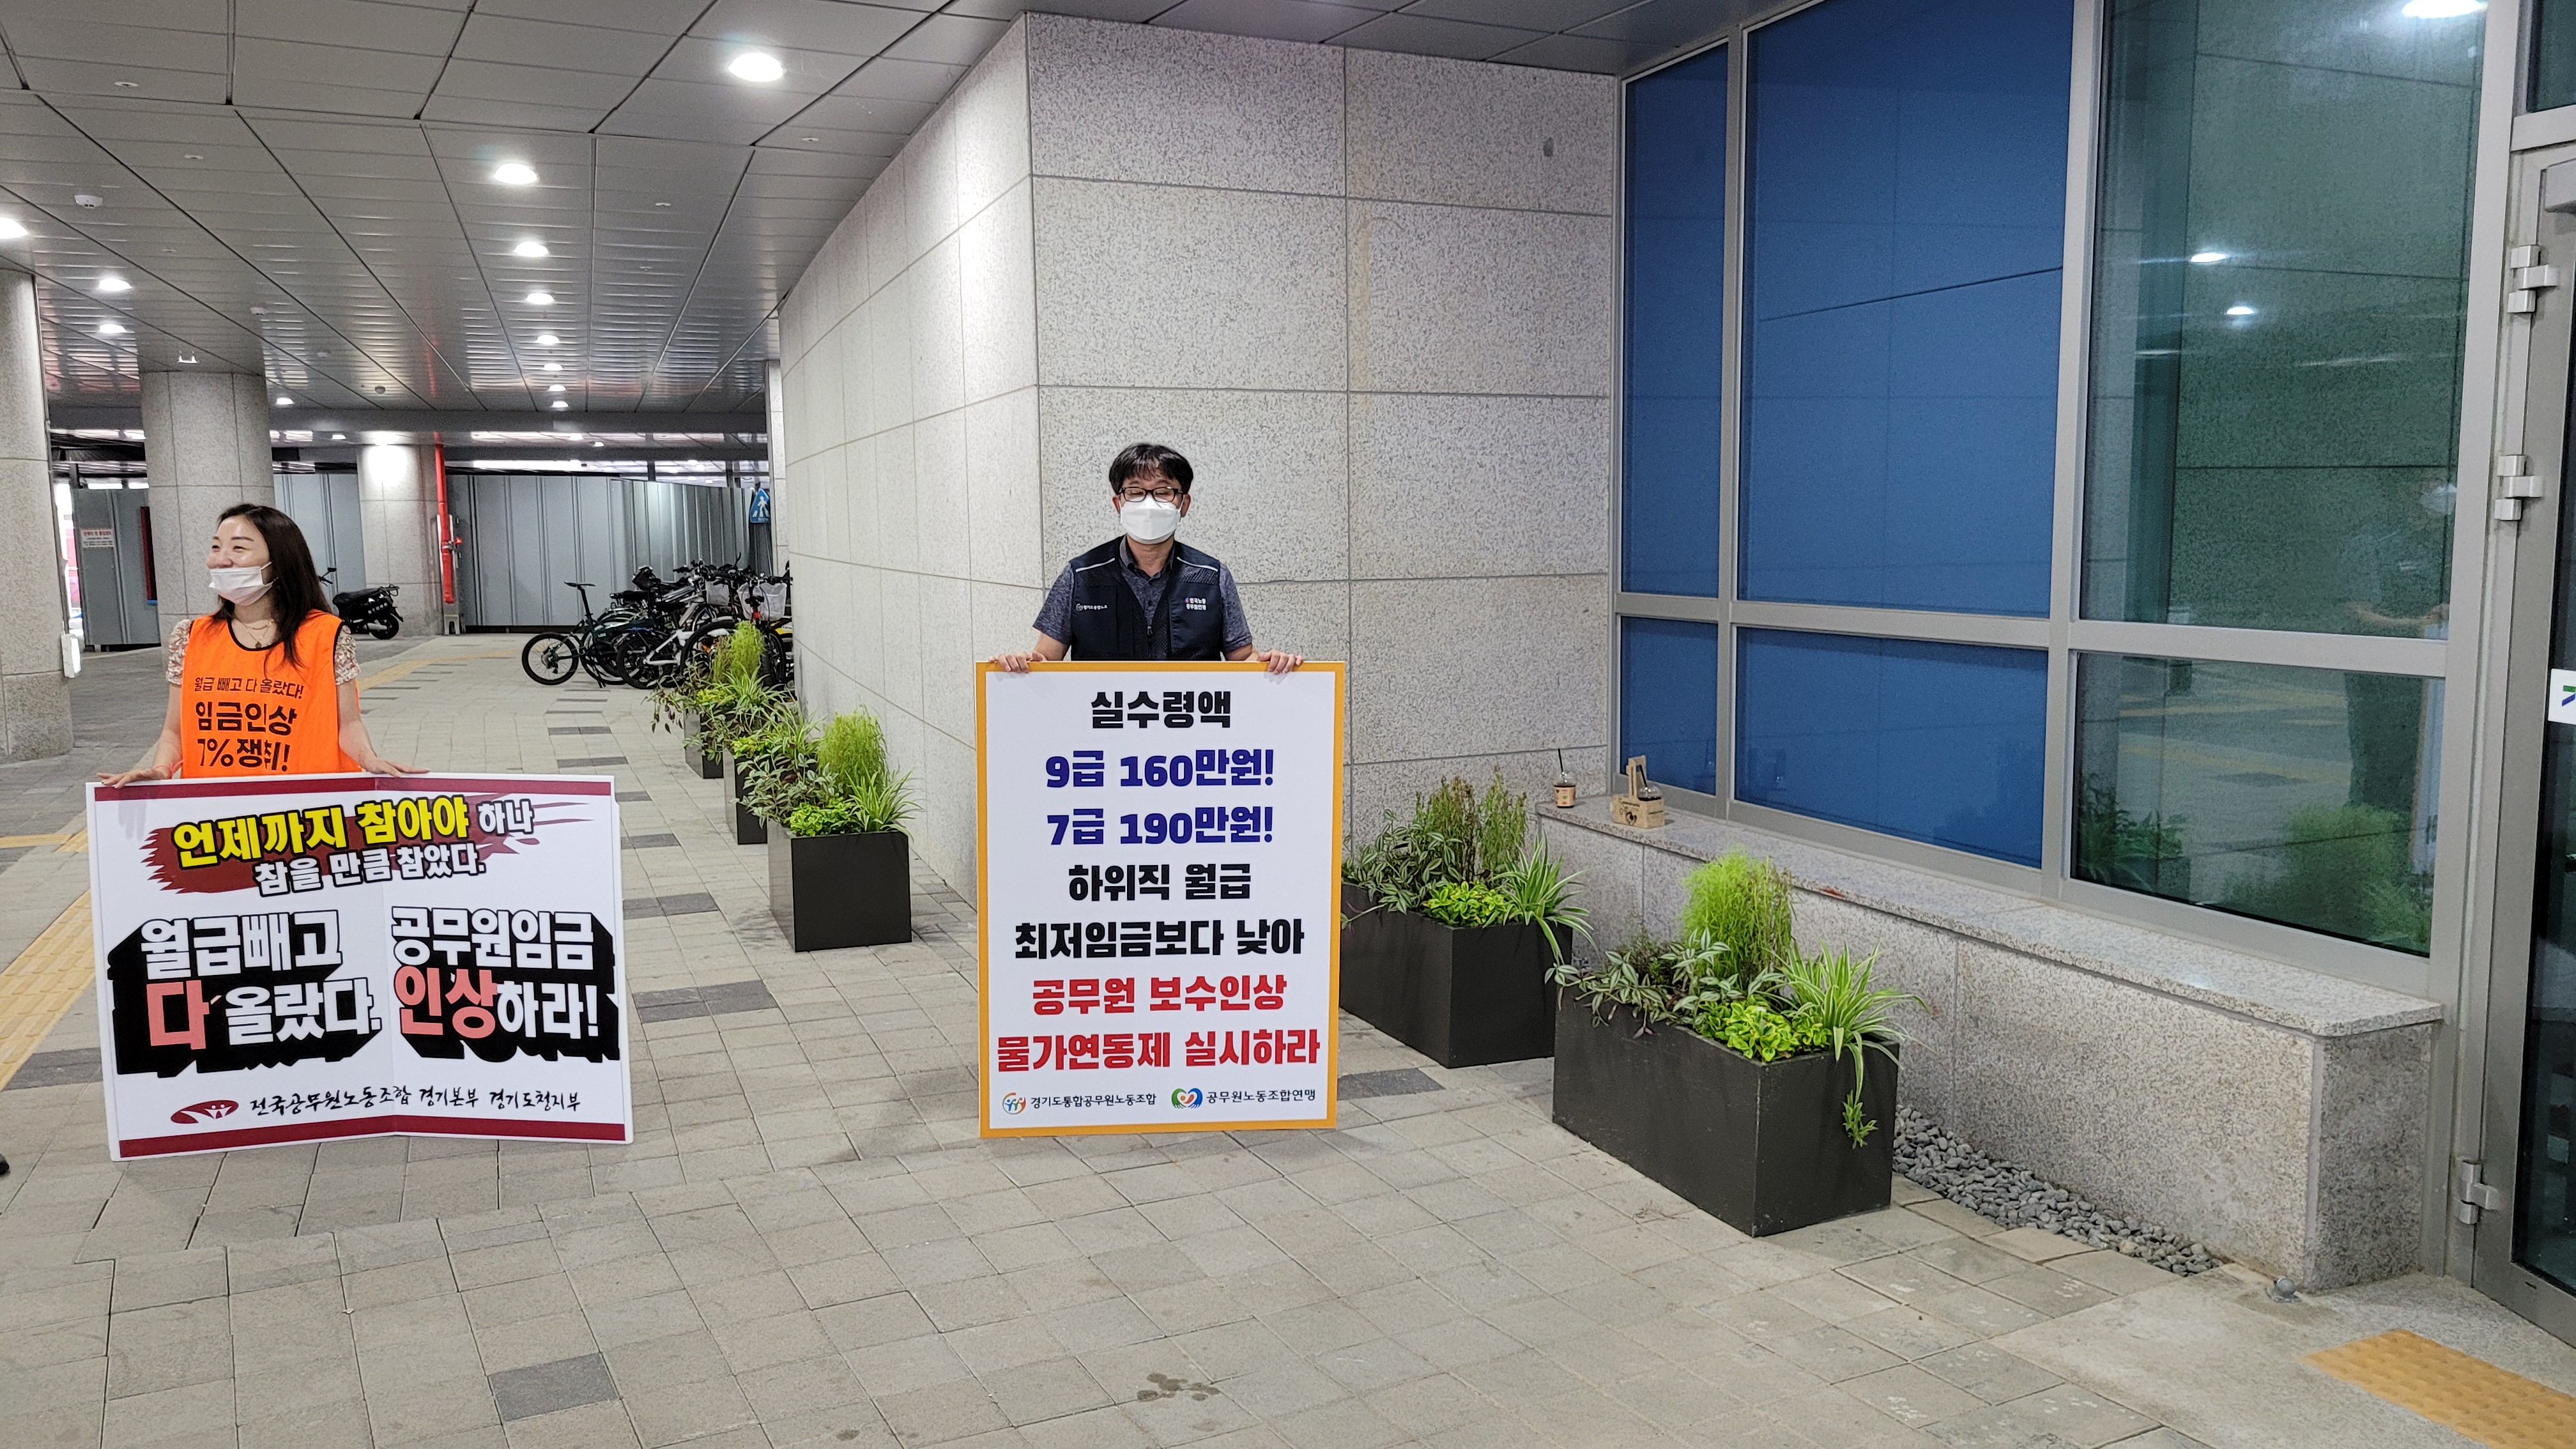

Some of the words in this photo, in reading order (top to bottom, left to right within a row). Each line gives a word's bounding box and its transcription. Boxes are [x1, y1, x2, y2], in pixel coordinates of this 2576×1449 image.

[194, 677, 215, 692] 월급
[217, 677, 243, 692] 빼고
[245, 678, 257, 692] 다
[260, 678, 304, 699] 올랐다!
[195, 701, 298, 735] 임금인상
[1091, 691, 1231, 729] 실수령액
[197, 739, 234, 767] 7%
[236, 739, 291, 772] 쟁취!
[1045, 750, 1105, 788] 9급
[1120, 749, 1274, 787] 160만원!
[173, 805, 346, 870] 언제까지
[357, 795, 470, 842] 참아야
[479, 799, 534, 835] 하나
[1047, 808, 1105, 845] 7급
[1120, 806, 1274, 844] 190만원!
[254, 854, 321, 896] 참을
[330, 848, 392, 884] 만큼
[398, 843, 486, 879] 참았다.
[1068, 864, 1170, 901] 하위직
[1184, 863, 1251, 900] 월급
[141, 910, 343, 980] 월급빼고
[392, 907, 594, 970] 공무원임금
[1015, 919, 1224, 959] 최저임금보다
[1236, 918, 1305, 955] 낮아
[146, 979, 211, 1049] 다
[225, 979, 382, 1046] 올랐다.
[394, 965, 601, 1039] 인상하라!
[1032, 977, 1135, 1016] 공무원
[1149, 974, 1287, 1012] 보수인상
[997, 1032, 1170, 1073] 물가연동제
[1184, 1029, 1321, 1067] 실시하라
[250, 1085, 412, 1116] 전국공무원노동조합
[419, 1085, 479, 1107] 경기본부
[489, 1089, 581, 1112] 경기도청지부
[1031, 1093, 1157, 1109] 경기도통합공무원노동조합
[1206, 1089, 1316, 1104] 공무원노동조합연맹
